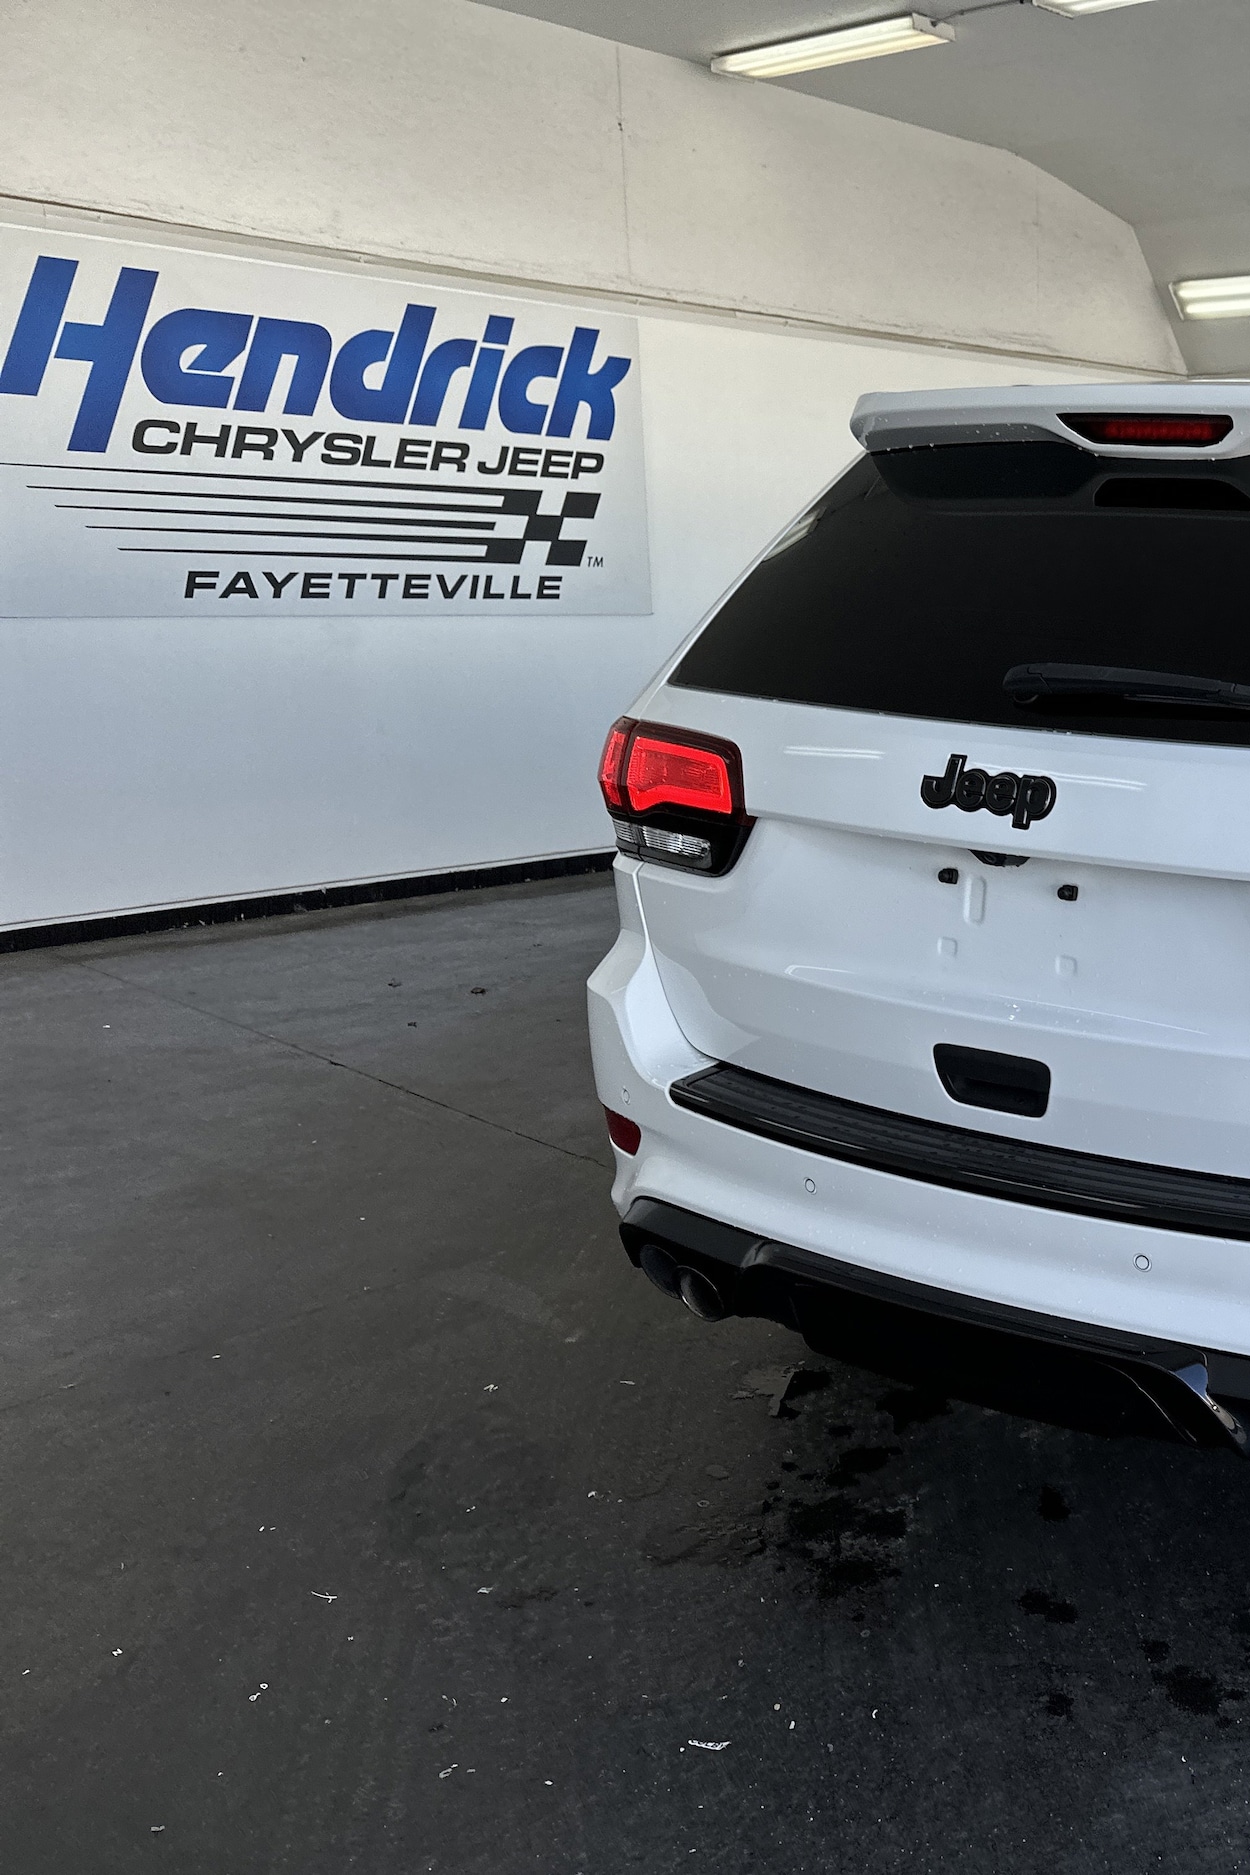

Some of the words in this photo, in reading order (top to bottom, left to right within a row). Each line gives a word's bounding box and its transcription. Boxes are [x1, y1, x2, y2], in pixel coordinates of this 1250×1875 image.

[0, 255, 631, 453] Hendrick
[131, 419, 471, 473] CHRYSLER
[477, 445, 605, 480] JEEP
[184, 570, 563, 600] FAYETTEVILLE
[587, 556, 604, 568] TM
[920, 753, 1057, 830] Jeep
